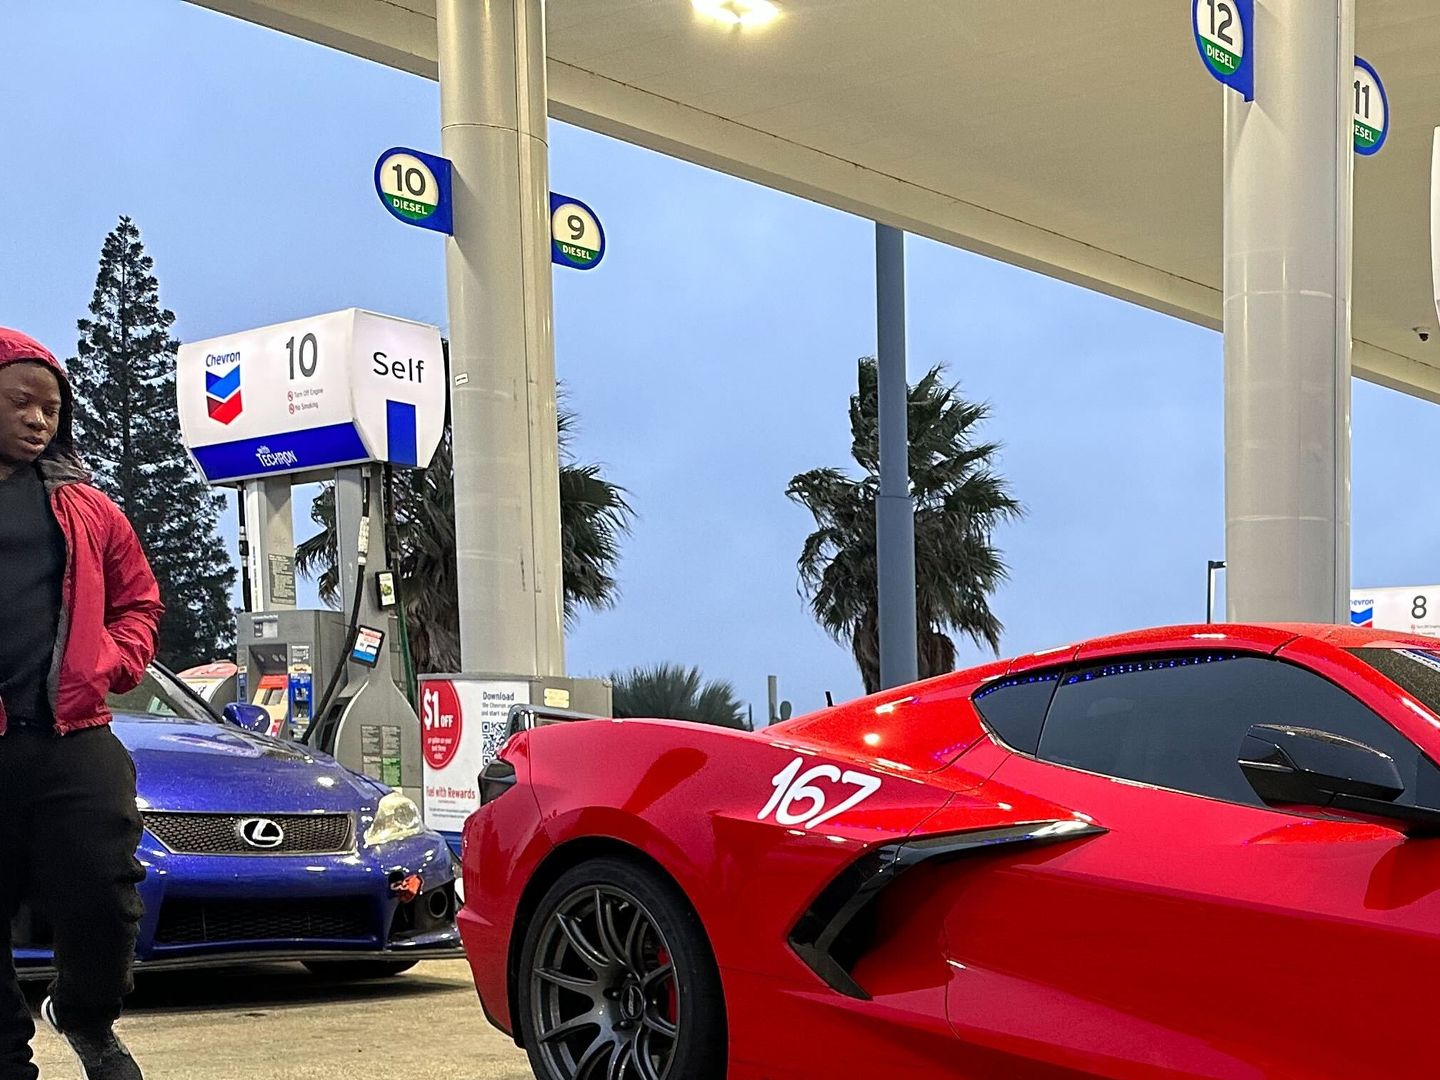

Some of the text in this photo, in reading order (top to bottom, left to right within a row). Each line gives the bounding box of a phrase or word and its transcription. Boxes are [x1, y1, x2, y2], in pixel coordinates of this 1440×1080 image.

[1207, 0, 1233, 45] 12
[1206, 44, 1235, 69] DIESEL
[1353, 80, 1370, 119] 11
[1354, 124, 1375, 142] ESEL
[392, 163, 426, 197] 10
[393, 198, 428, 216] DIESEL
[567, 214, 585, 240] 9
[562, 244, 592, 261] DIESEL
[205, 351, 241, 368] Chevron
[286, 332, 318, 380] 10
[372, 351, 425, 384] Self
[255, 450, 298, 468] TECHRON
[1411, 595, 1427, 619] 8
[482, 691, 515, 701] Download
[423, 688, 440, 730] $1
[440, 715, 454, 728] OFF
[435, 787, 447, 798] with
[447, 786, 476, 800] Rewards
[757, 756, 882, 829] 167
